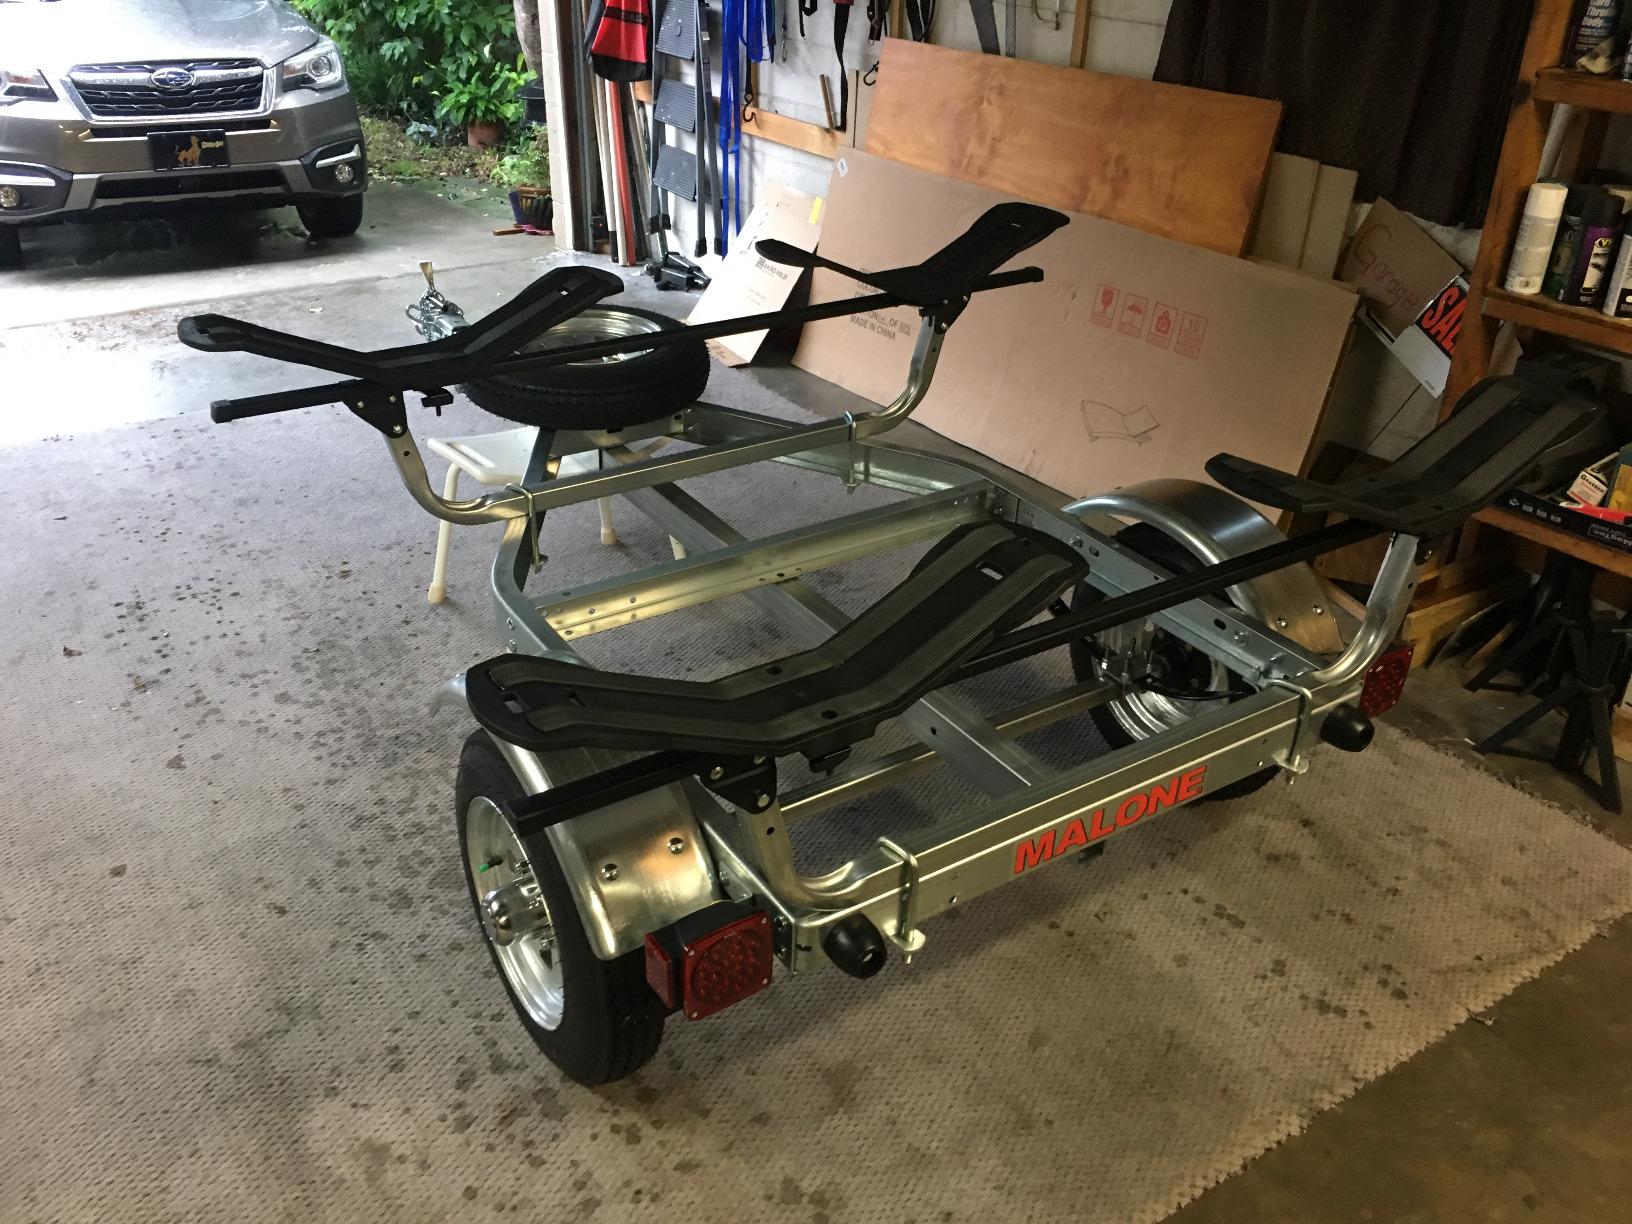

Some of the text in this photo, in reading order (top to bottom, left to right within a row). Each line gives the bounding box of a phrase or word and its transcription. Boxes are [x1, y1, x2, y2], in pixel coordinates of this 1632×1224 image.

[850, 315, 896, 341] MADE IN CHINA
[889, 318, 899, 328] OF
[1421, 286, 1469, 353] SAL
[1013, 765, 1207, 875] MALONE
